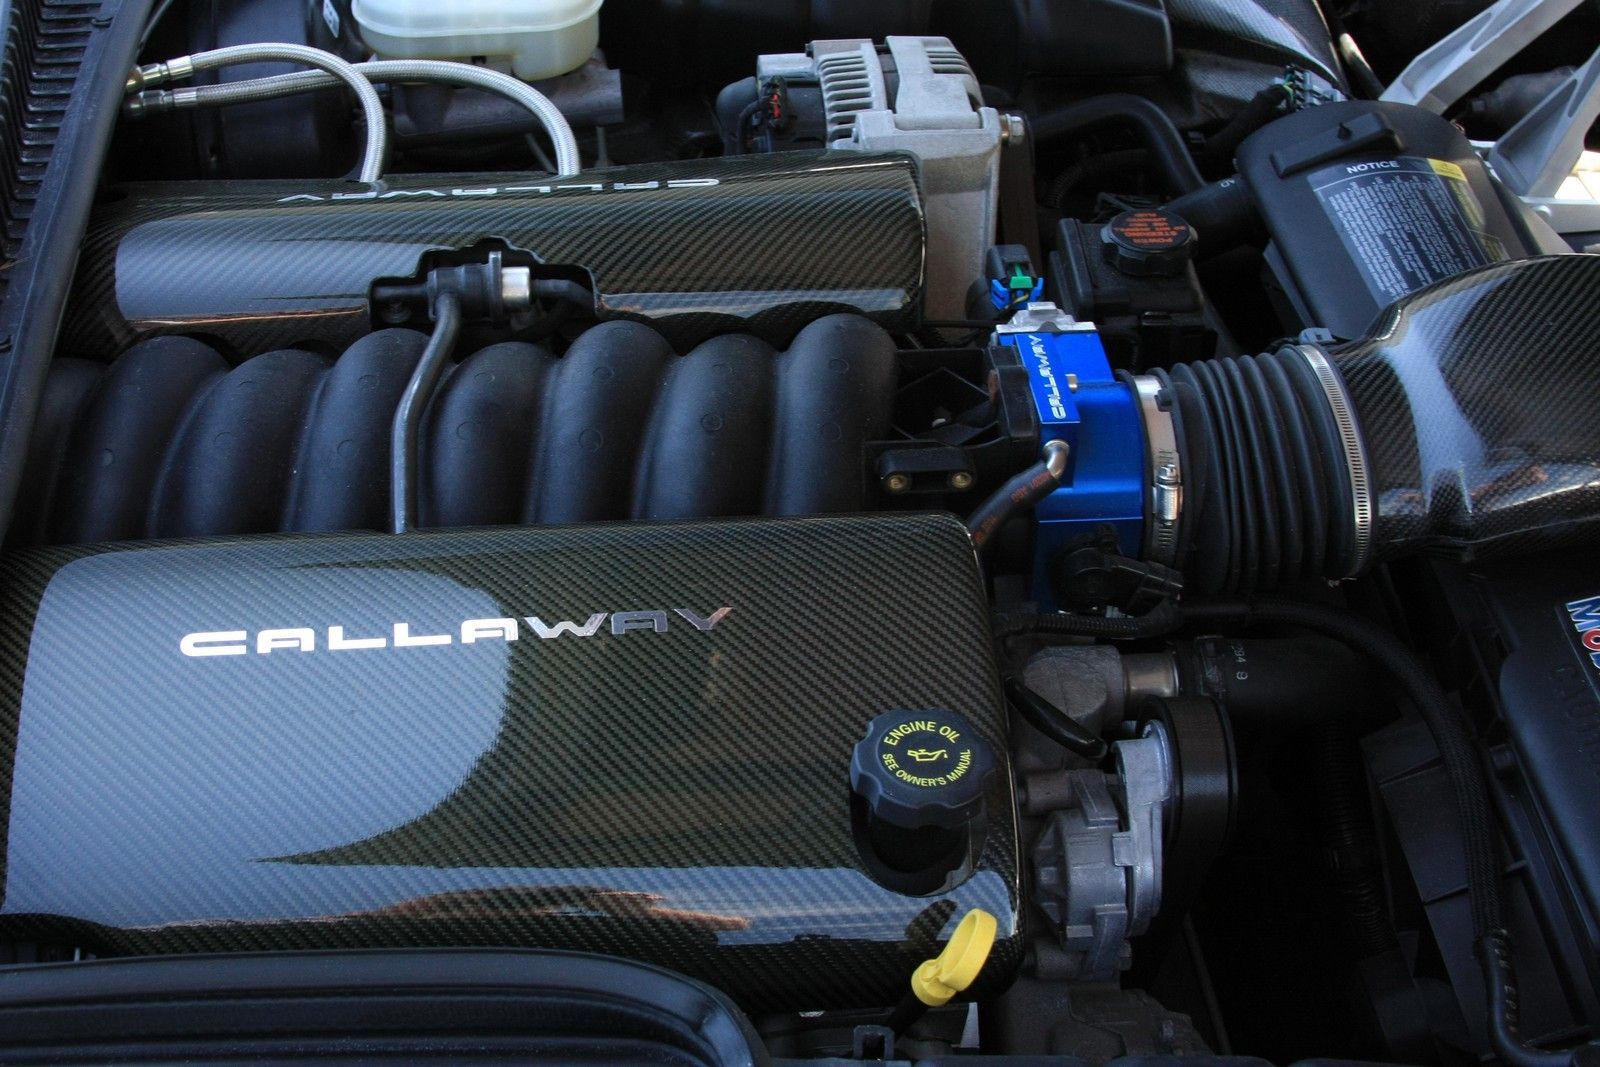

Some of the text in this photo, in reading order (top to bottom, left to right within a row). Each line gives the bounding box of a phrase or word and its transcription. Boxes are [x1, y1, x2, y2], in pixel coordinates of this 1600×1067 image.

[1346, 161, 1399, 174] NOTICE
[277, 177, 720, 202] CALLAWAY
[1028, 335, 1067, 419] CALLAWAY
[180, 606, 733, 657] CALLAWAY
[883, 721, 961, 746] ENGINE OIL
[882, 749, 972, 787] SEE OWNER'S MANUAL
